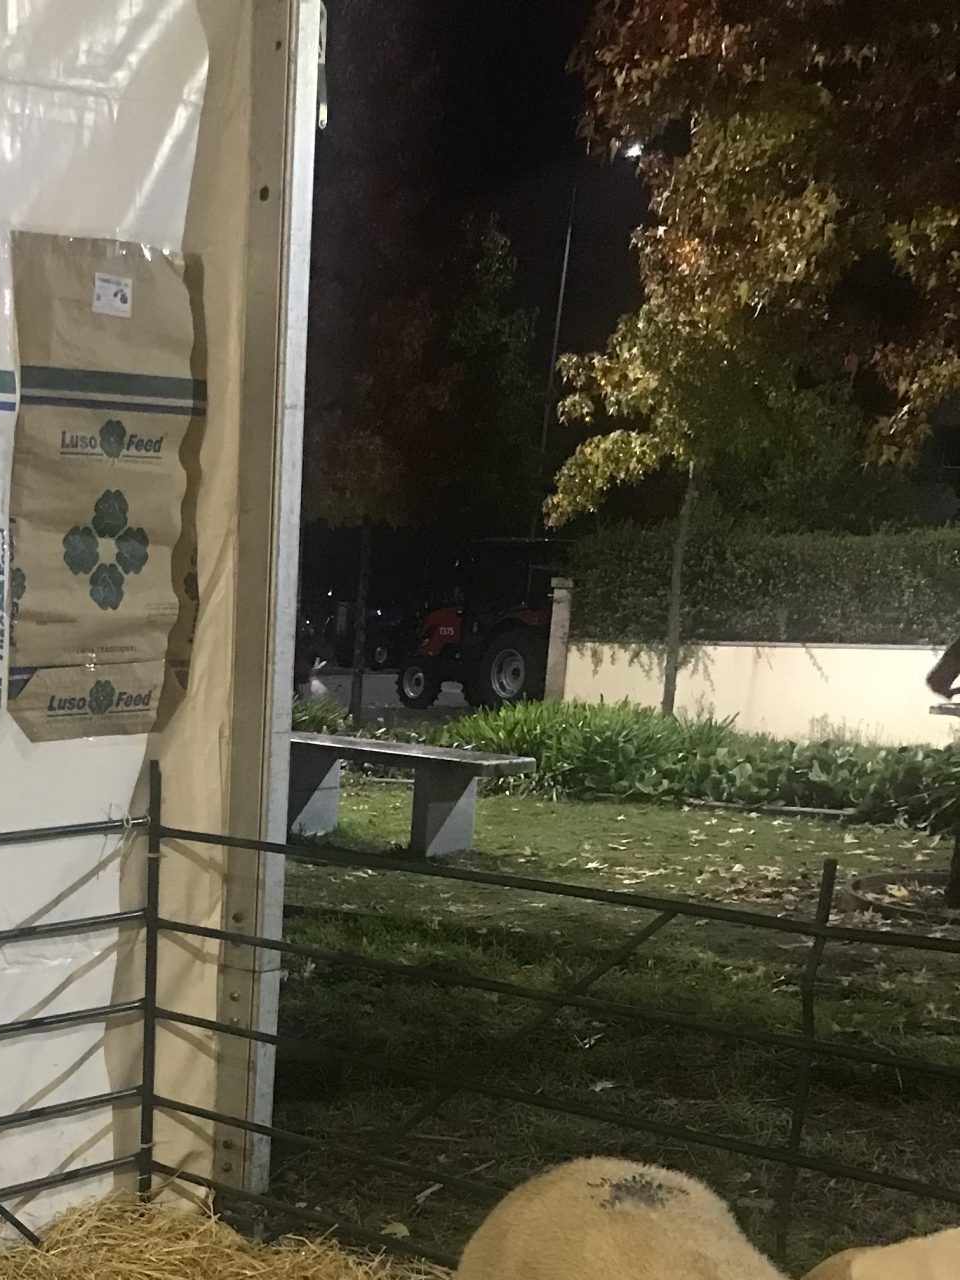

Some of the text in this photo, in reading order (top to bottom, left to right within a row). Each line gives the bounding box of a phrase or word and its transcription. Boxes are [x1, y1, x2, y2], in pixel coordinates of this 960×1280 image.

[60, 430, 164, 453] Luso Feed
[47, 690, 152, 712] Luso Feed
